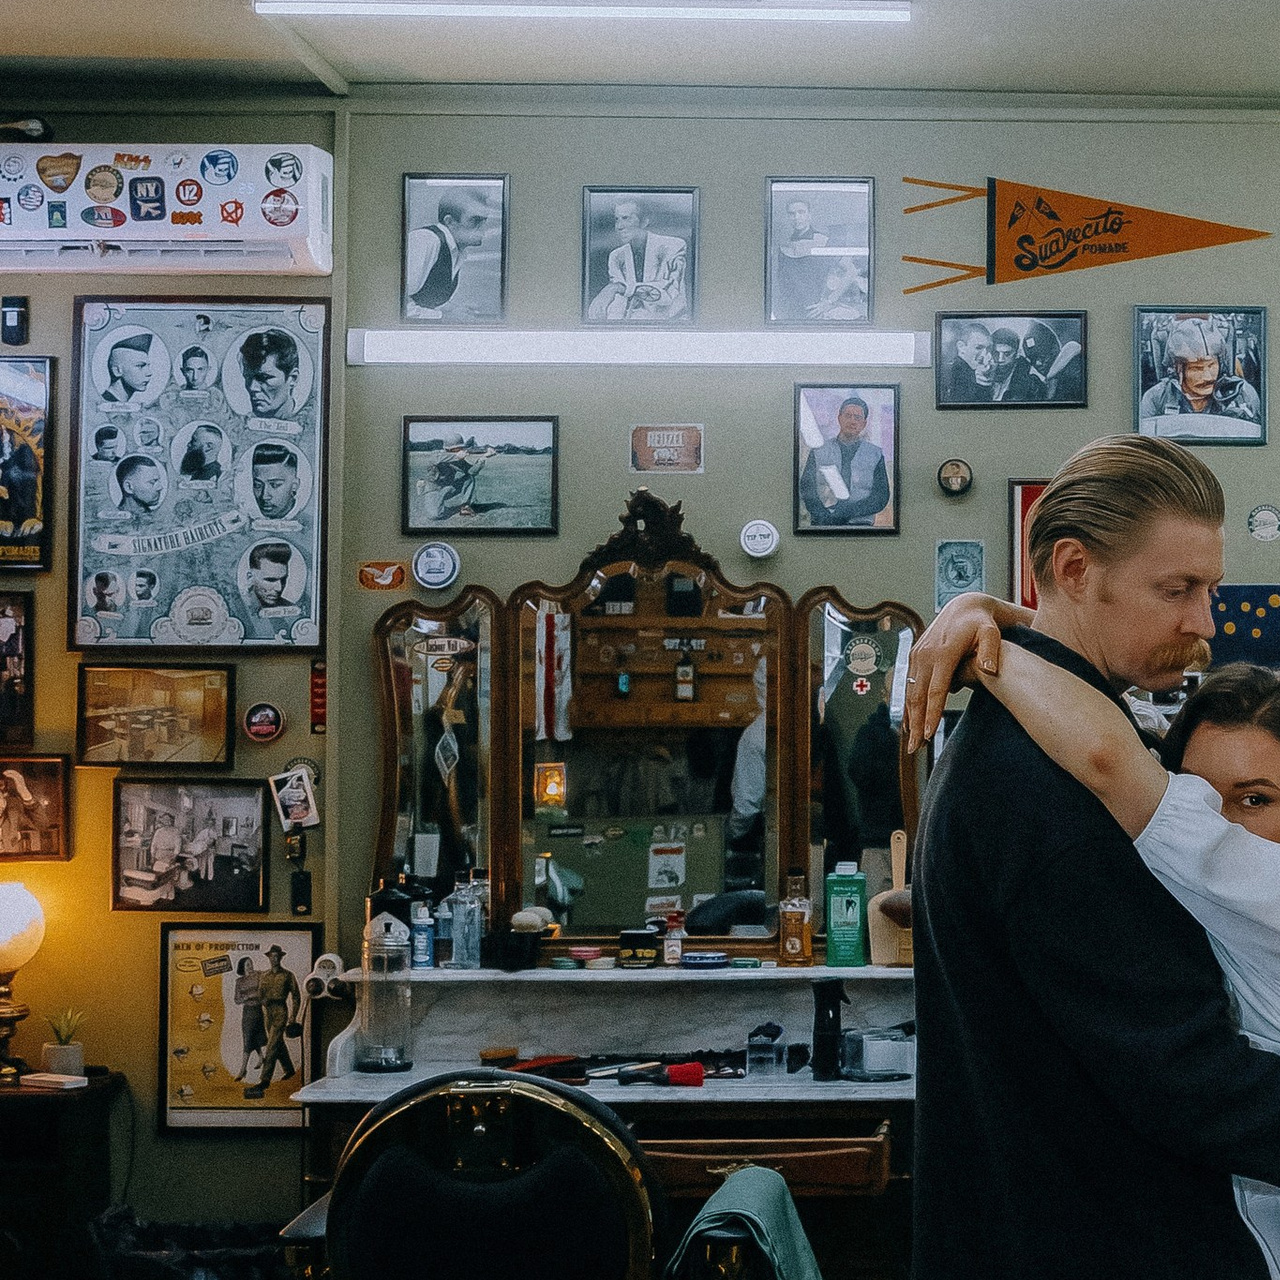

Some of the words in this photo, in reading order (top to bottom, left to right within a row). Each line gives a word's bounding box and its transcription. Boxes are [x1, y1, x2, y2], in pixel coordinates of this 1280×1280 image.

[137, 183, 156, 197] NY
[179, 185, 197, 200] U2
[1014, 207, 1133, 271] Suavecito
[1082, 242, 1129, 254] POMADE
[132, 533, 181, 553] SIGNATURE
[184, 520, 227, 545] HAIRCUTS
[174, 943, 191, 951] MEN
[195, 943, 204, 951] OF
[209, 943, 260, 951] PRODUCTION
